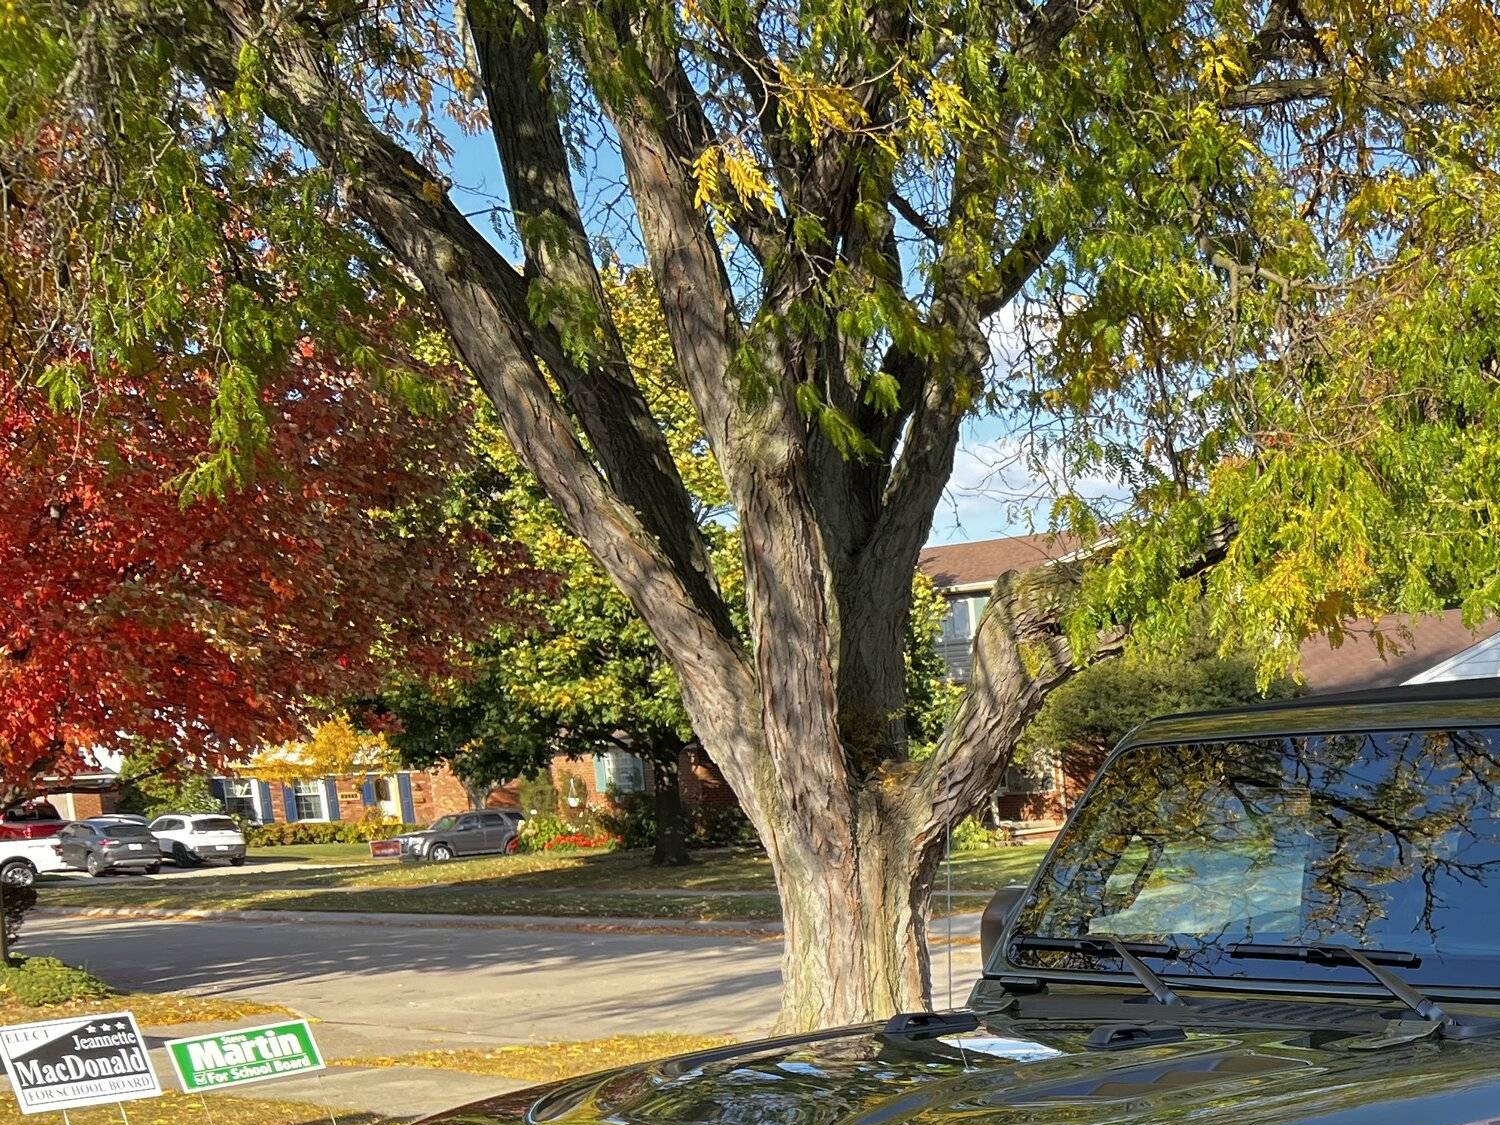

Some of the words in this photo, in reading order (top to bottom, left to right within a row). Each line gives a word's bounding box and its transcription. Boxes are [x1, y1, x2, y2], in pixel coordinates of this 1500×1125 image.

[72, 1032, 137, 1051] Jeannette
[187, 1030, 303, 1072] Martin
[12, 1046, 148, 1087] MacDonald
[205, 1071, 229, 1084] For
[229, 1062, 272, 1080] School
[273, 1055, 311, 1072] Board
[28, 1088, 57, 1102] FOR
[57, 1083, 106, 1097] SCHOOL
[108, 1076, 150, 1090] BOARD
